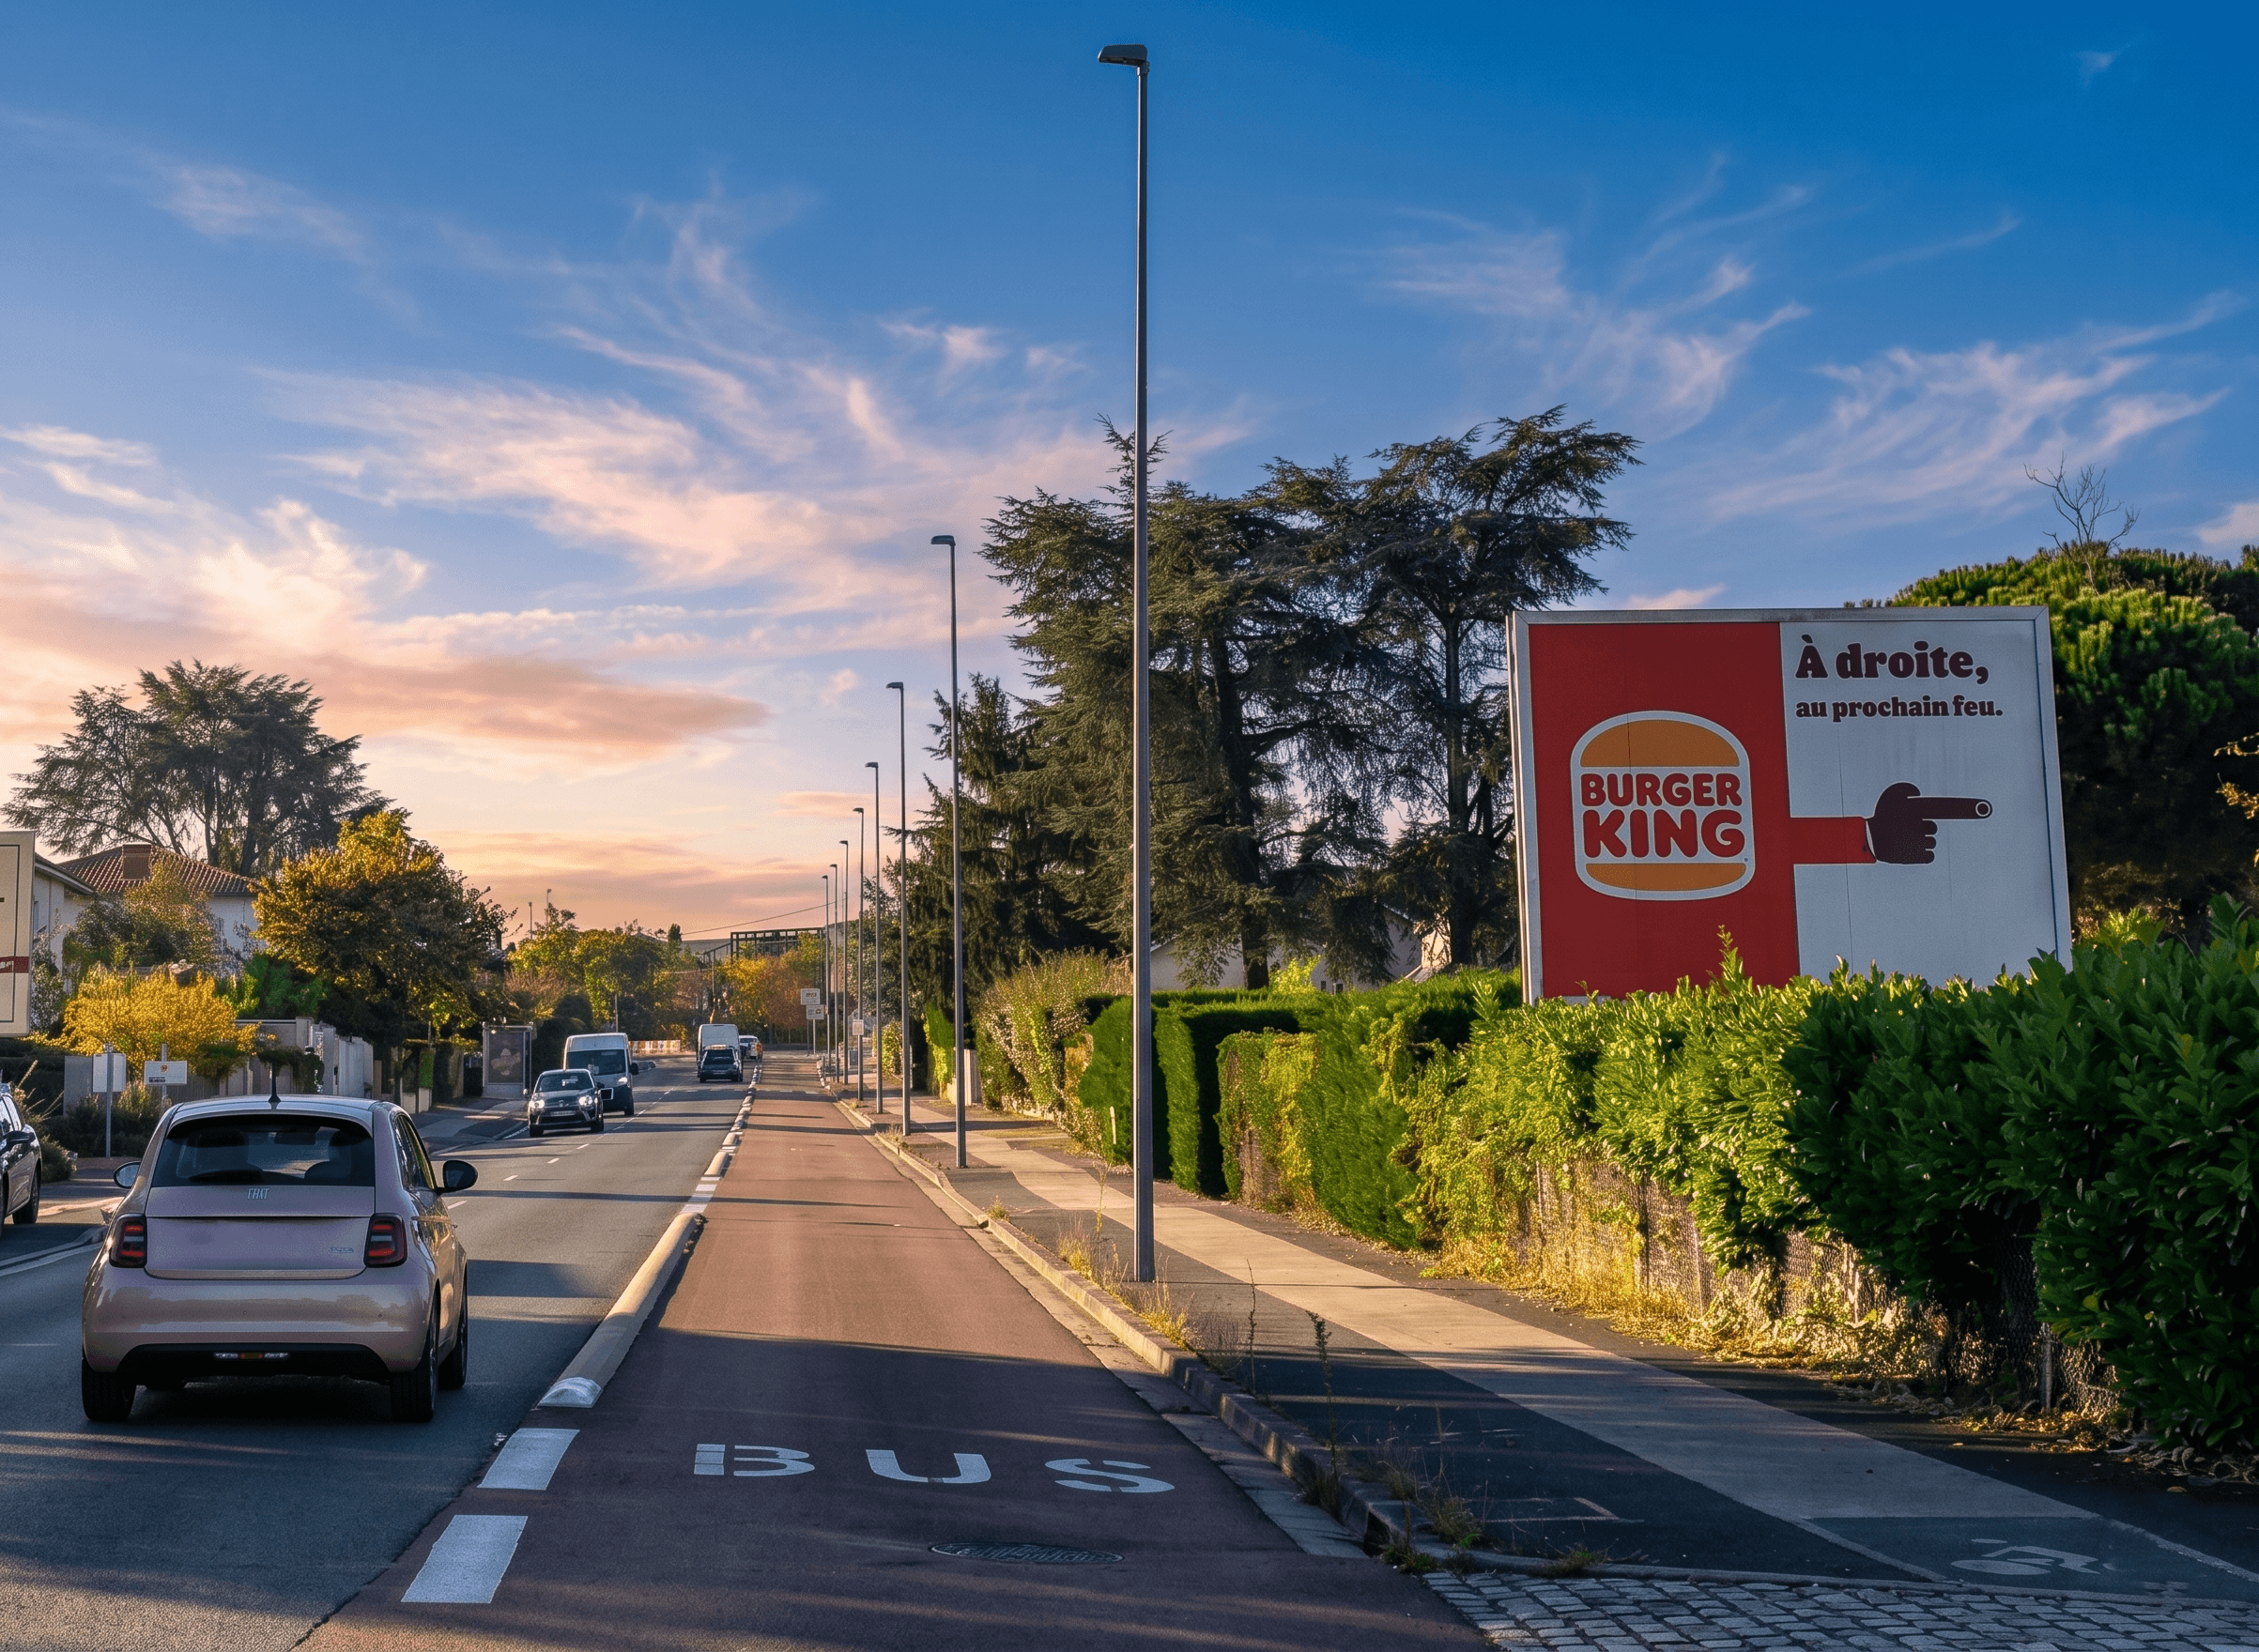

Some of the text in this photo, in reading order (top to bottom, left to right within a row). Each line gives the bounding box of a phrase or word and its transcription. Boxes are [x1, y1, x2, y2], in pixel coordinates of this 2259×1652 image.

[1795, 634, 1990, 685] À droite,
[1795, 695, 2004, 723] au prochain feu.
[1580, 772, 1743, 807] BURGER
[1582, 808, 1745, 858] KING
[693, 1443, 1176, 1494] BUS
